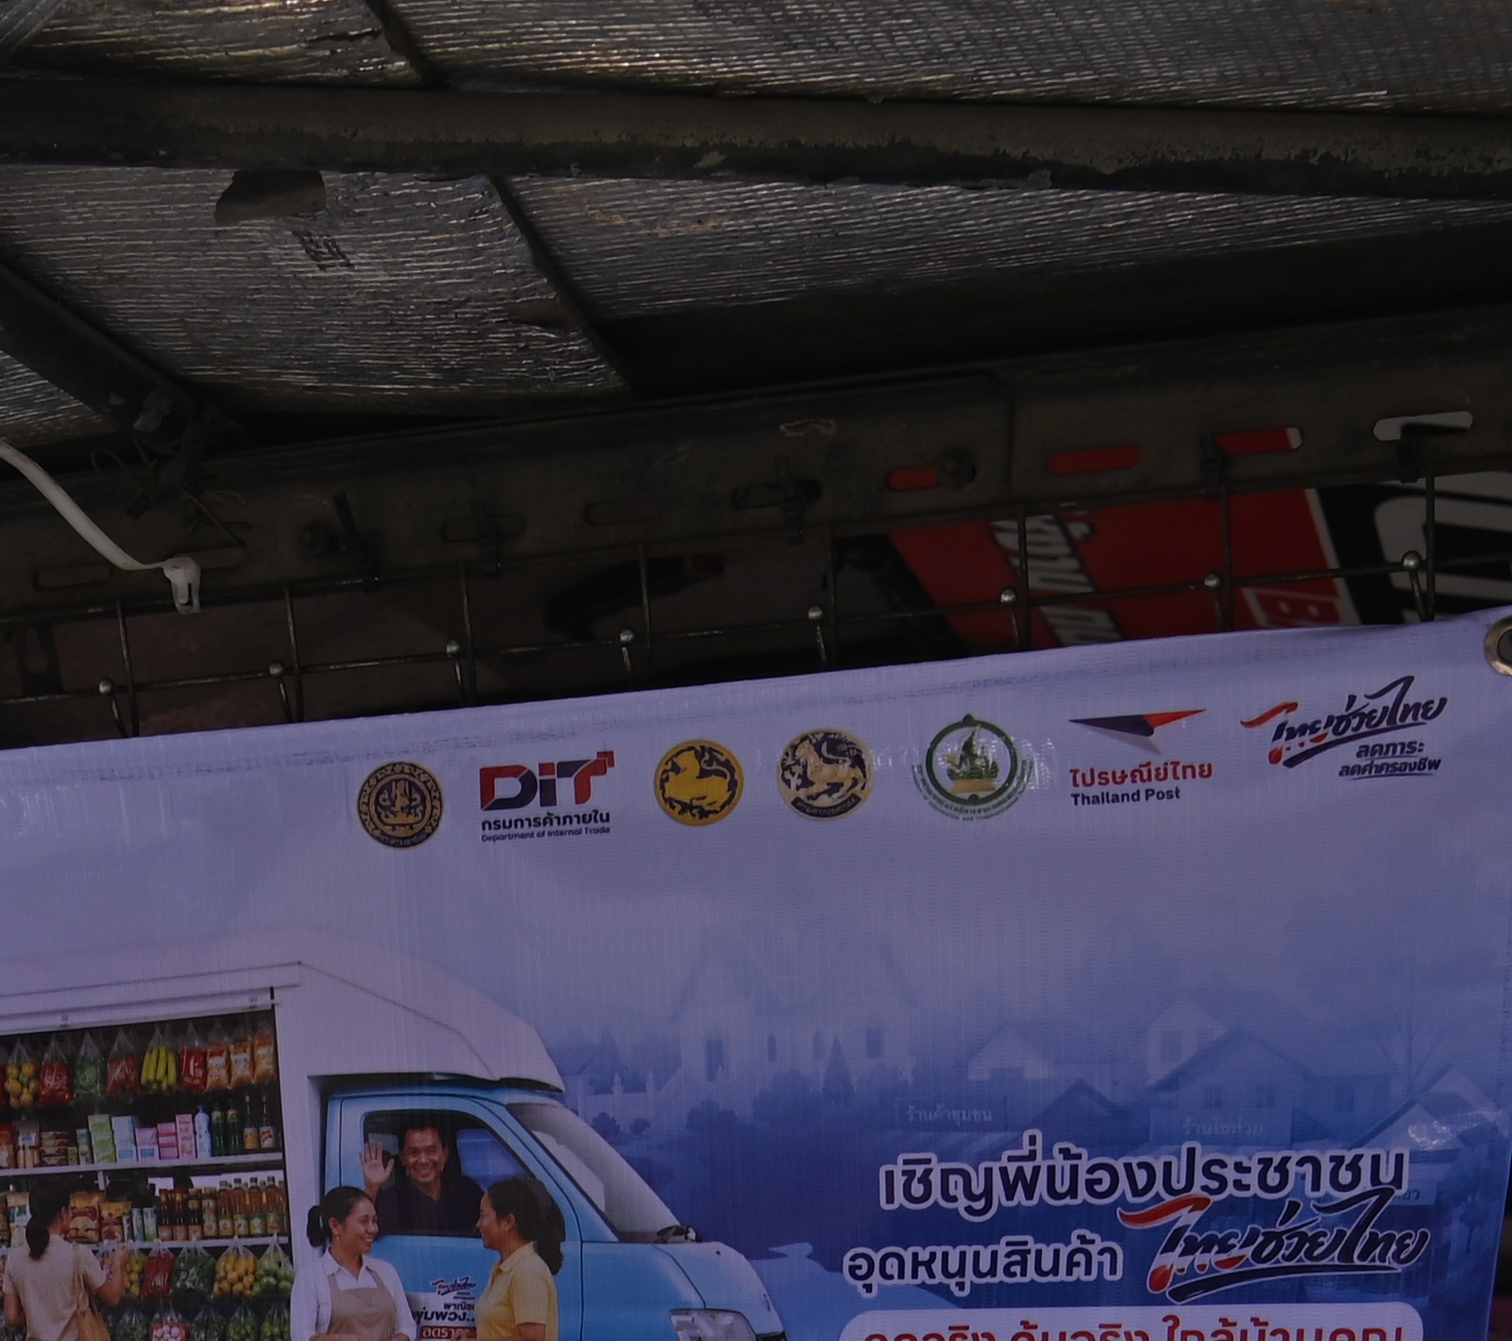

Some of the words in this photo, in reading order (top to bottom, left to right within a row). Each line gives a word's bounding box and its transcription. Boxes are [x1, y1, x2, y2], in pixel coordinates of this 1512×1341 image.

[1356, 740, 1424, 759] ลดภาระ
[1069, 760, 1213, 789] ไปรษณีย์ไทย
[1071, 789, 1140, 806] Thailand
[1145, 786, 1181, 802] Post
[481, 809, 610, 831] กรมการค้าภายใน
[883, 1131, 1406, 1215] เชิญพี่น้องประชาชน
[847, 1234, 1119, 1293] อุดหนุนสินค้า
